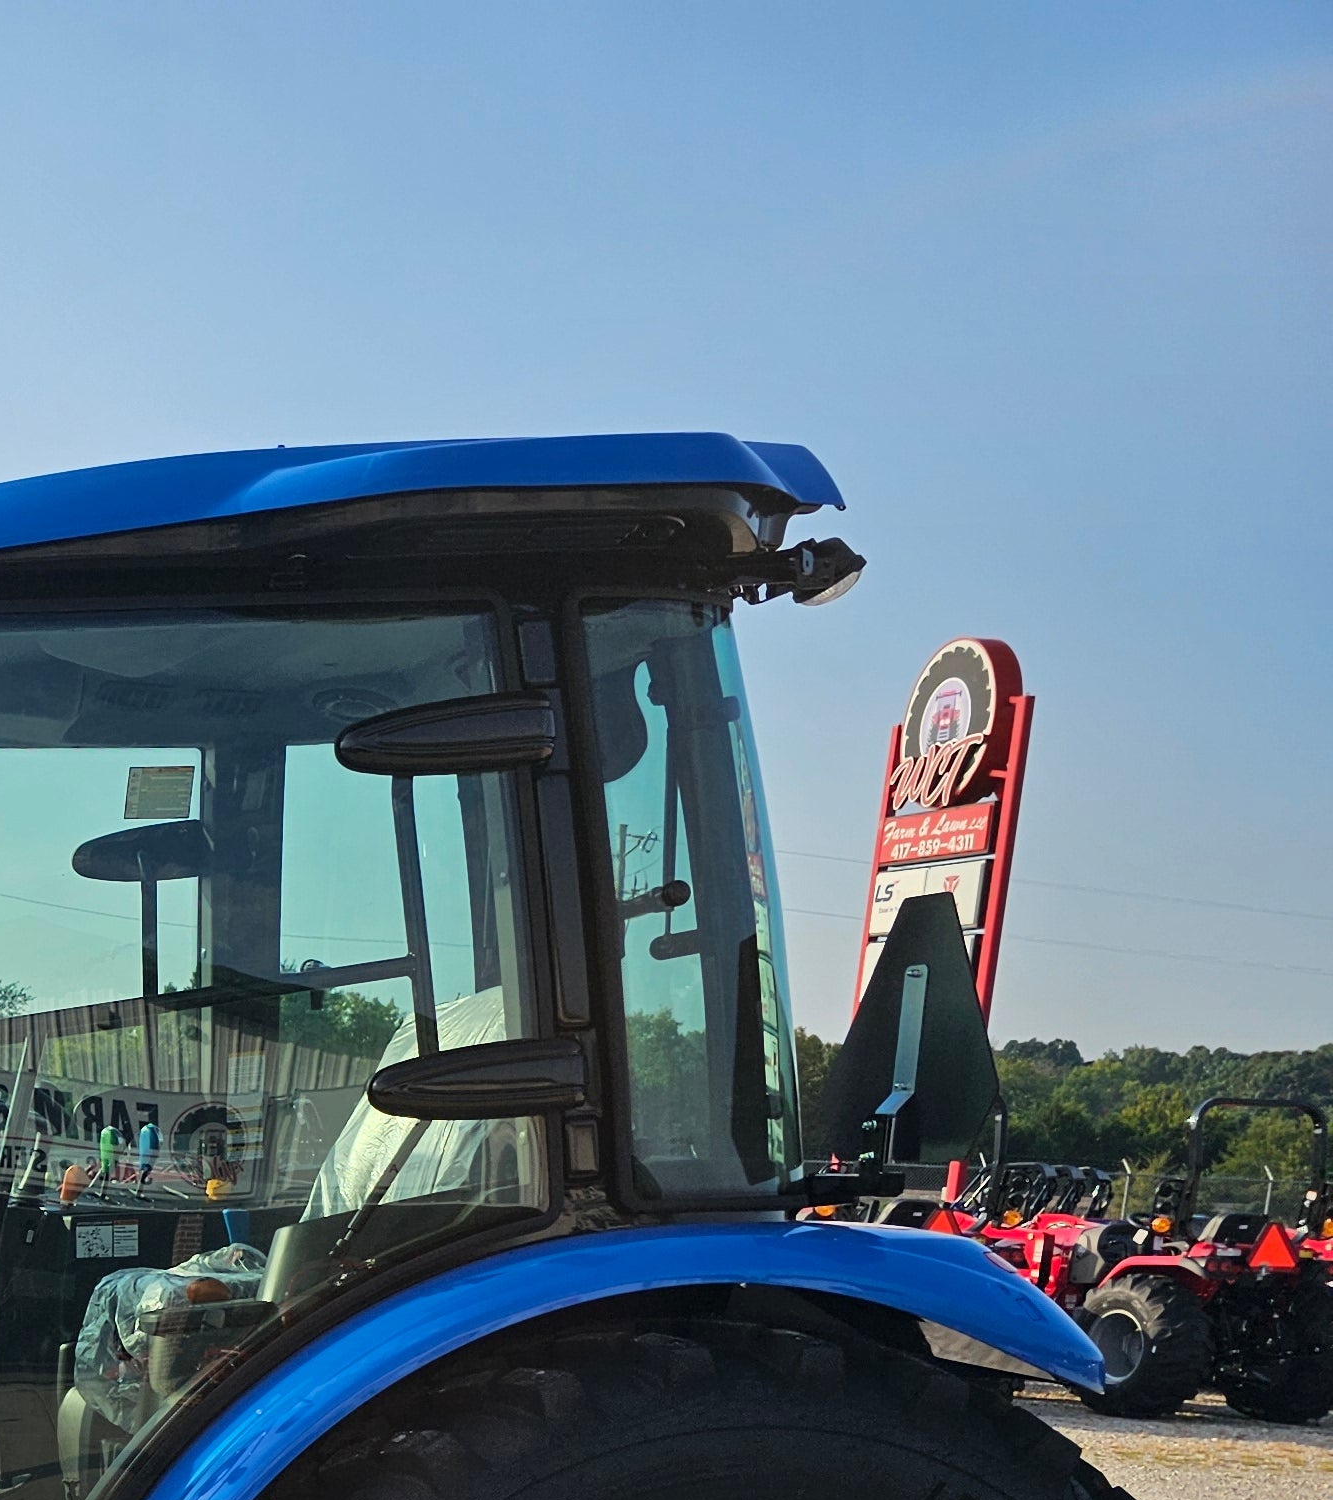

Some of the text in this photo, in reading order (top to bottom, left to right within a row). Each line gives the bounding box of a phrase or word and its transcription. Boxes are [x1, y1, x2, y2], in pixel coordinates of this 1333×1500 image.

[889, 733, 984, 810] WCT
[884, 820, 916, 845] Farm
[919, 815, 932, 837] &
[931, 813, 968, 836] Lawn
[890, 833, 976, 860] 417-859-4311
[875, 883, 895, 902] LS
